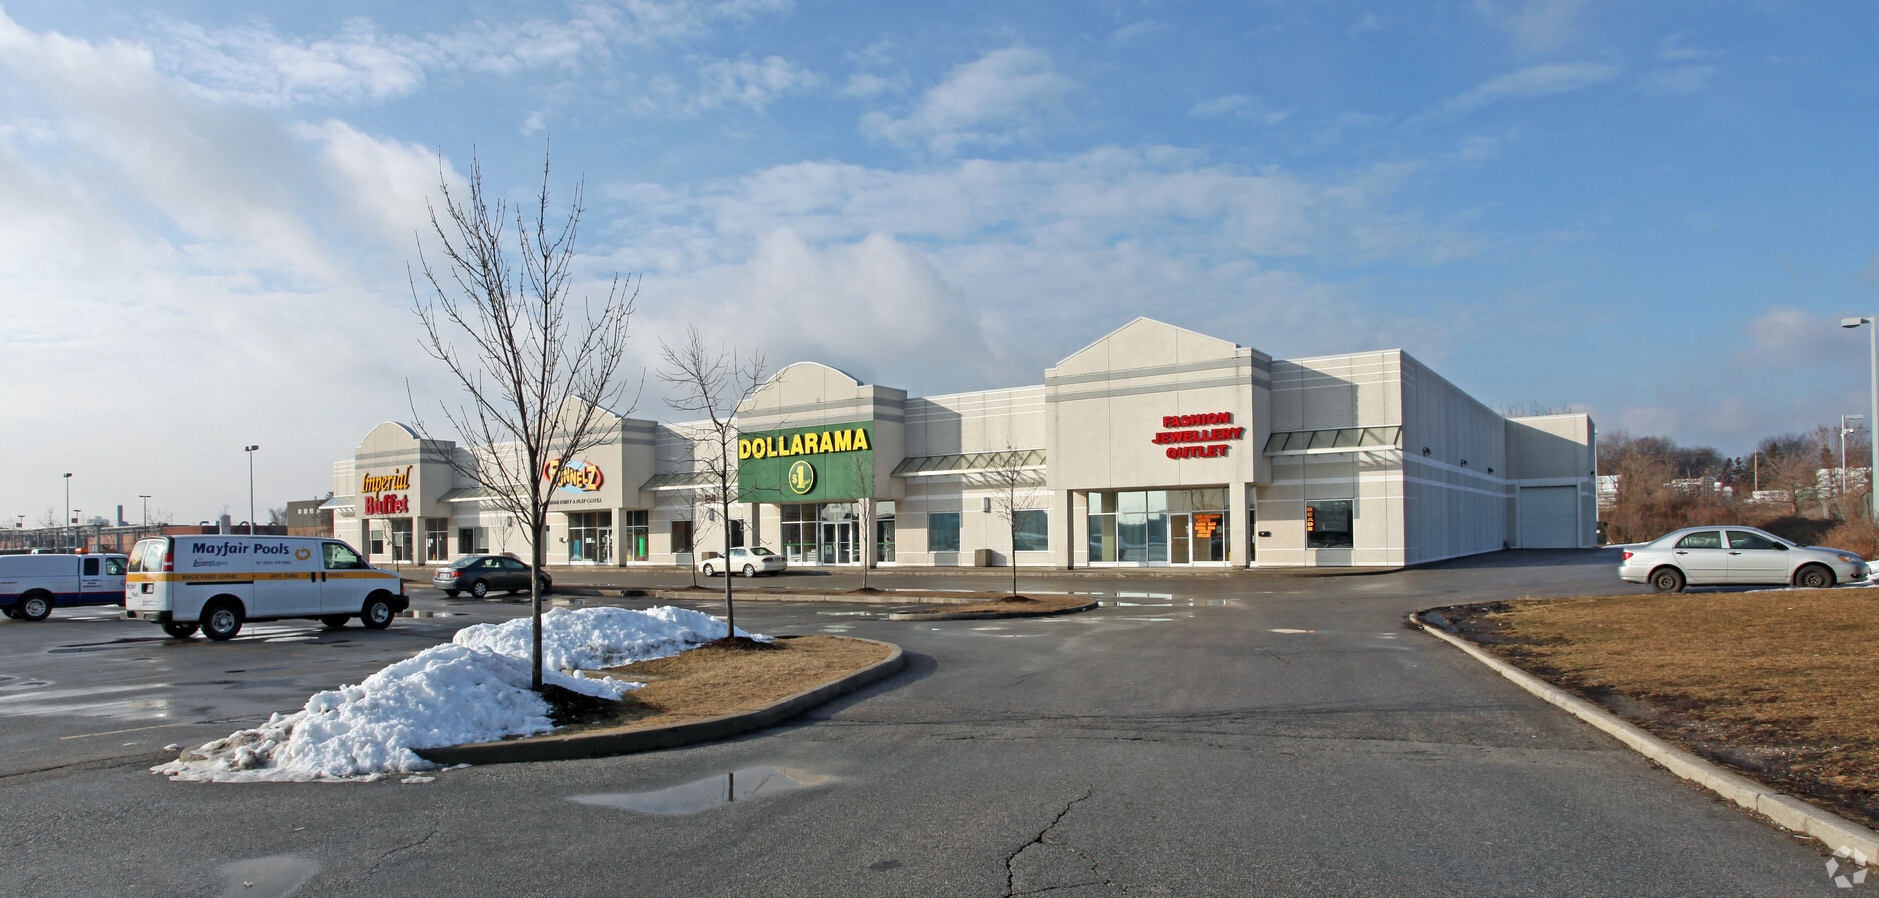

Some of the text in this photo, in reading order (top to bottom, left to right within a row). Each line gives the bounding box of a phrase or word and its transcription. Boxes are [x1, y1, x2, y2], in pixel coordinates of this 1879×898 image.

[1163, 412, 1231, 428] FASHION
[738, 427, 869, 460] DOLLARAMA
[1151, 427, 1244, 444] JEWELLERY
[1166, 444, 1229, 459] OUTLET
[361, 465, 412, 502] Imperial
[364, 494, 409, 515] Buffet
[192, 542, 290, 557] Mayfair Pools
